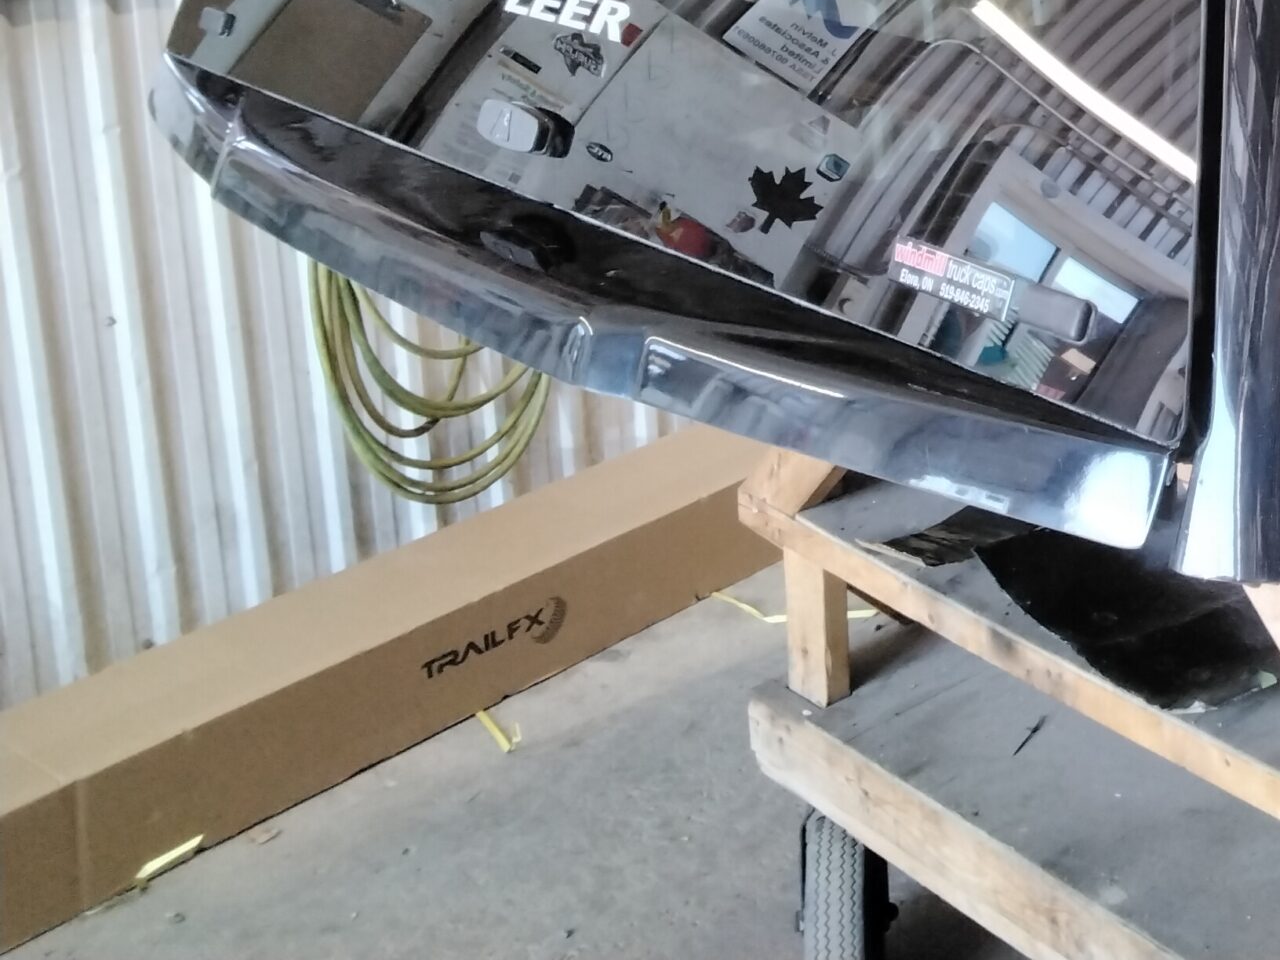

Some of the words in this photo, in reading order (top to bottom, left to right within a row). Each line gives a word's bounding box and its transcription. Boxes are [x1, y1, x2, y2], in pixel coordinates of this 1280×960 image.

[895, 241, 949, 278] windmill
[946, 259, 971, 285] truck
[971, 272, 996, 296] caps
[921, 276, 934, 292] ON
[939, 282, 991, 313] 519-846-2345
[421, 607, 545, 679] TRAILFX
